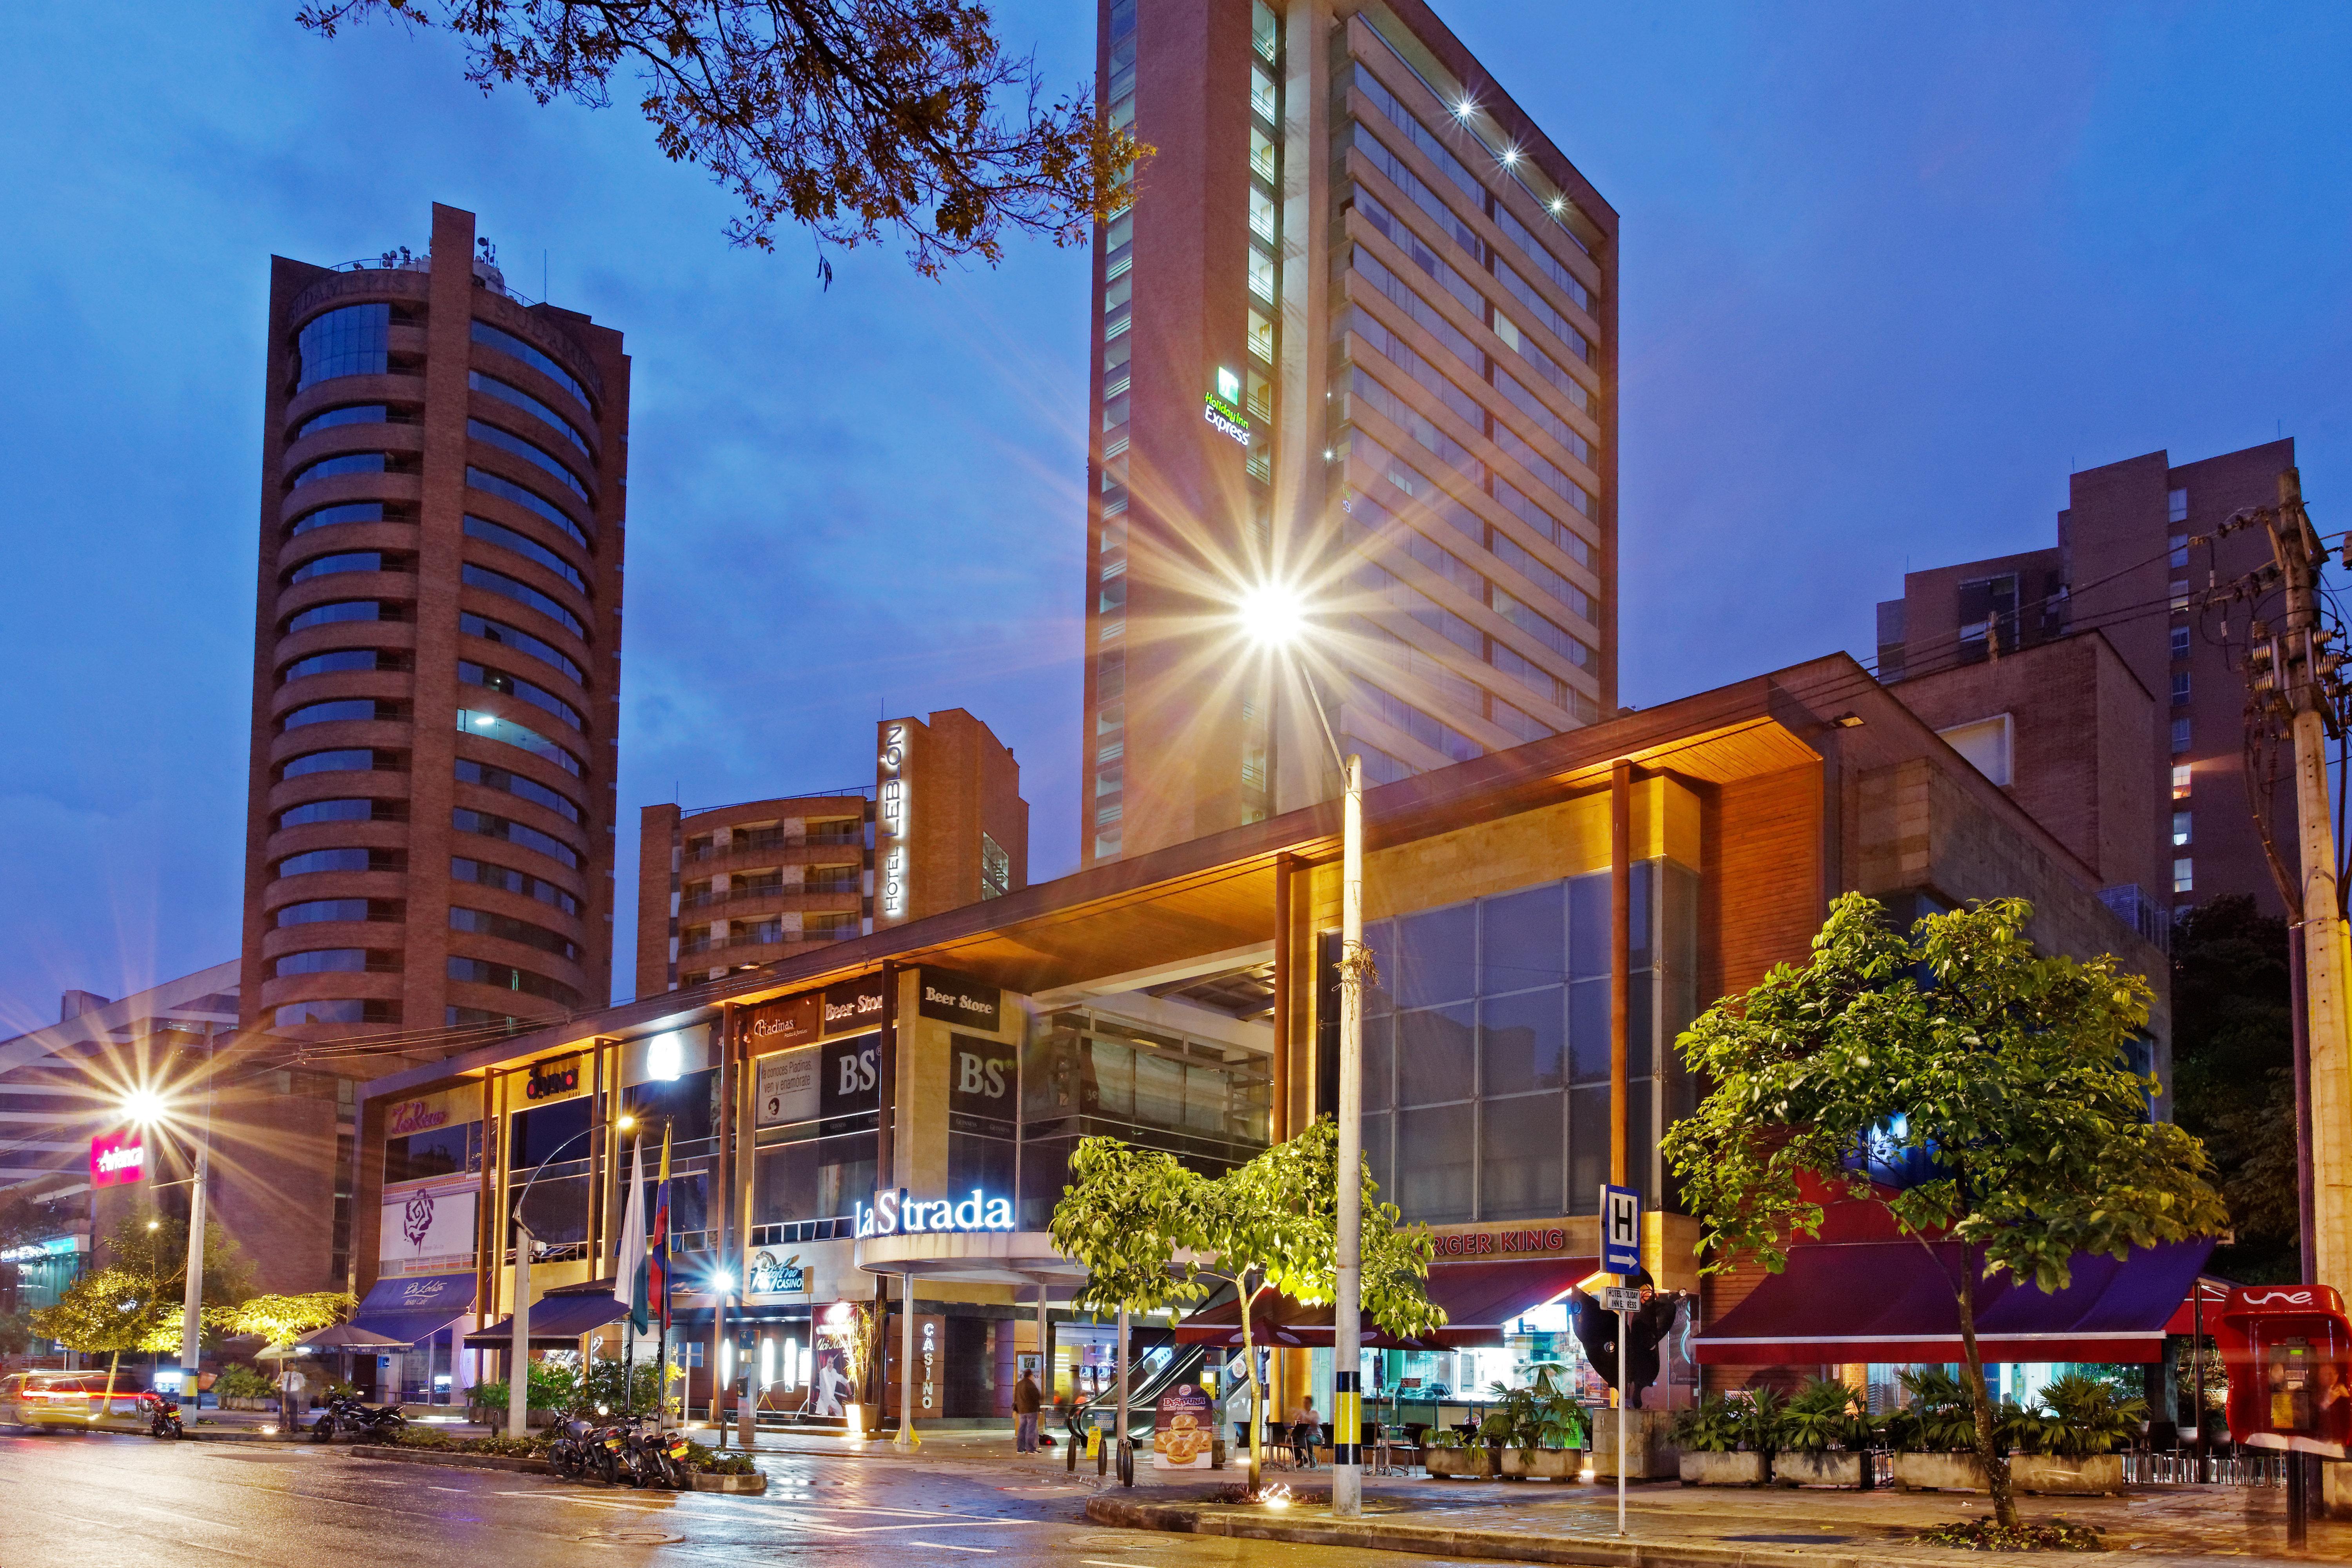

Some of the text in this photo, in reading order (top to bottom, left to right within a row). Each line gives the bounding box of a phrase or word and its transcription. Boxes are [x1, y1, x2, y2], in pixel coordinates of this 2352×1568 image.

[1205, 404, 1250, 446] Express
[885, 846, 900, 912] HOTEL
[825, 1002, 854, 1021] Beer
[925, 986, 993, 1014] Beer Store
[754, 1019, 795, 1037] Piadinas
[767, 1065, 788, 1078] conoces
[838, 1049, 877, 1096] BS
[958, 1051, 1006, 1098] BS
[764, 1082, 774, 1093] ven
[775, 1081, 779, 1094] y
[1613, 1198, 1633, 1242] H
[1415, 1228, 1563, 1256] URGER KING
[776, 1278, 802, 1289] CASINO
[1608, 1289, 1639, 1299] HOTEL OLIDAY
[1620, 1300, 1637, 1309] ERESS
[922, 1323, 935, 1409] CASINO
